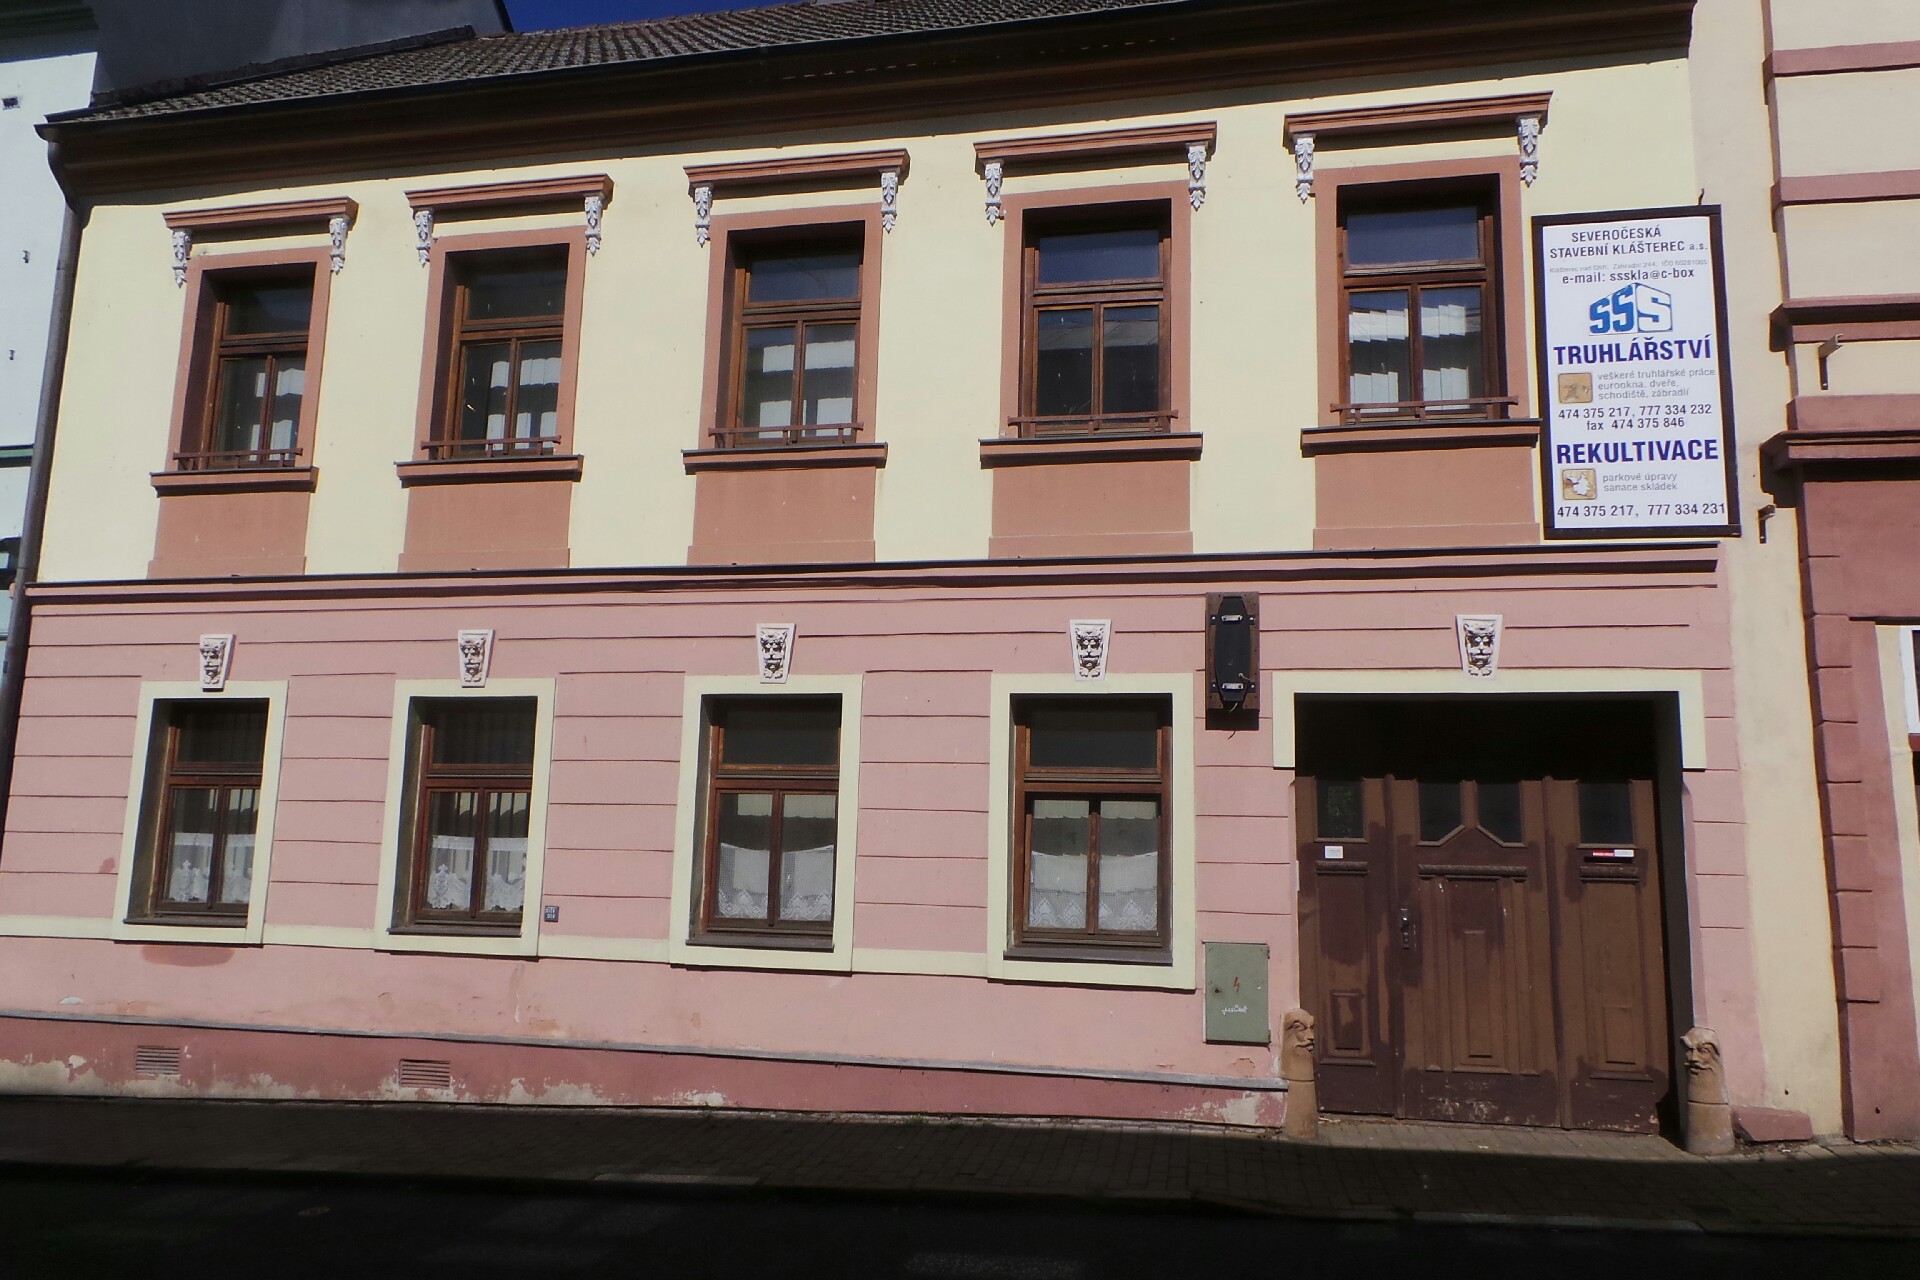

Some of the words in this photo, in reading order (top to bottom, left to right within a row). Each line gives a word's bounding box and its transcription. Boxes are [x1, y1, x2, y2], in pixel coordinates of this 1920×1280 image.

[1571, 224, 1662, 243] SEVEROČESKÁ
[1550, 244, 1608, 259] STAVEBNÍ
[1612, 240, 1685, 255] KLÁŠTEREC
[1689, 242, 1708, 251] a.s.
[1562, 272, 1606, 284] e-mail:
[1609, 267, 1695, 282] ssskla@c-box
[1553, 333, 1713, 366] TRUHLÁŘSTVÍ
[1597, 370, 1635, 380] veškeré
[1637, 369, 1686, 379] truhlářské
[1689, 368, 1716, 377] práce
[1649, 379, 1679, 389] dveře,
[1651, 388, 1690, 398] zábradlí
[1558, 409, 1580, 419] 474
[1583, 408, 1604, 418] 375
[1608, 407, 1635, 418] 217,
[1639, 405, 1661, 416] 777
[1665, 405, 1686, 415] 334
[1690, 404, 1712, 414] 232
[1586, 420, 1604, 431] fax
[1611, 419, 1634, 430] 474
[1637, 418, 1659, 428] 375
[1663, 417, 1685, 428] 846
[1556, 439, 1718, 464] REKULTIVACE
[1602, 472, 1642, 483] parkové
[1644, 471, 1678, 482] úpravy
[1603, 483, 1638, 492] sanace
[1641, 482, 1678, 492] skládek
[1557, 506, 1580, 517] 474
[1583, 505, 1606, 517] 375
[1610, 505, 1639, 518] 217,
[1647, 504, 1671, 516] 777
[1674, 503, 1698, 515] 334
[1702, 502, 1726, 514] 231
